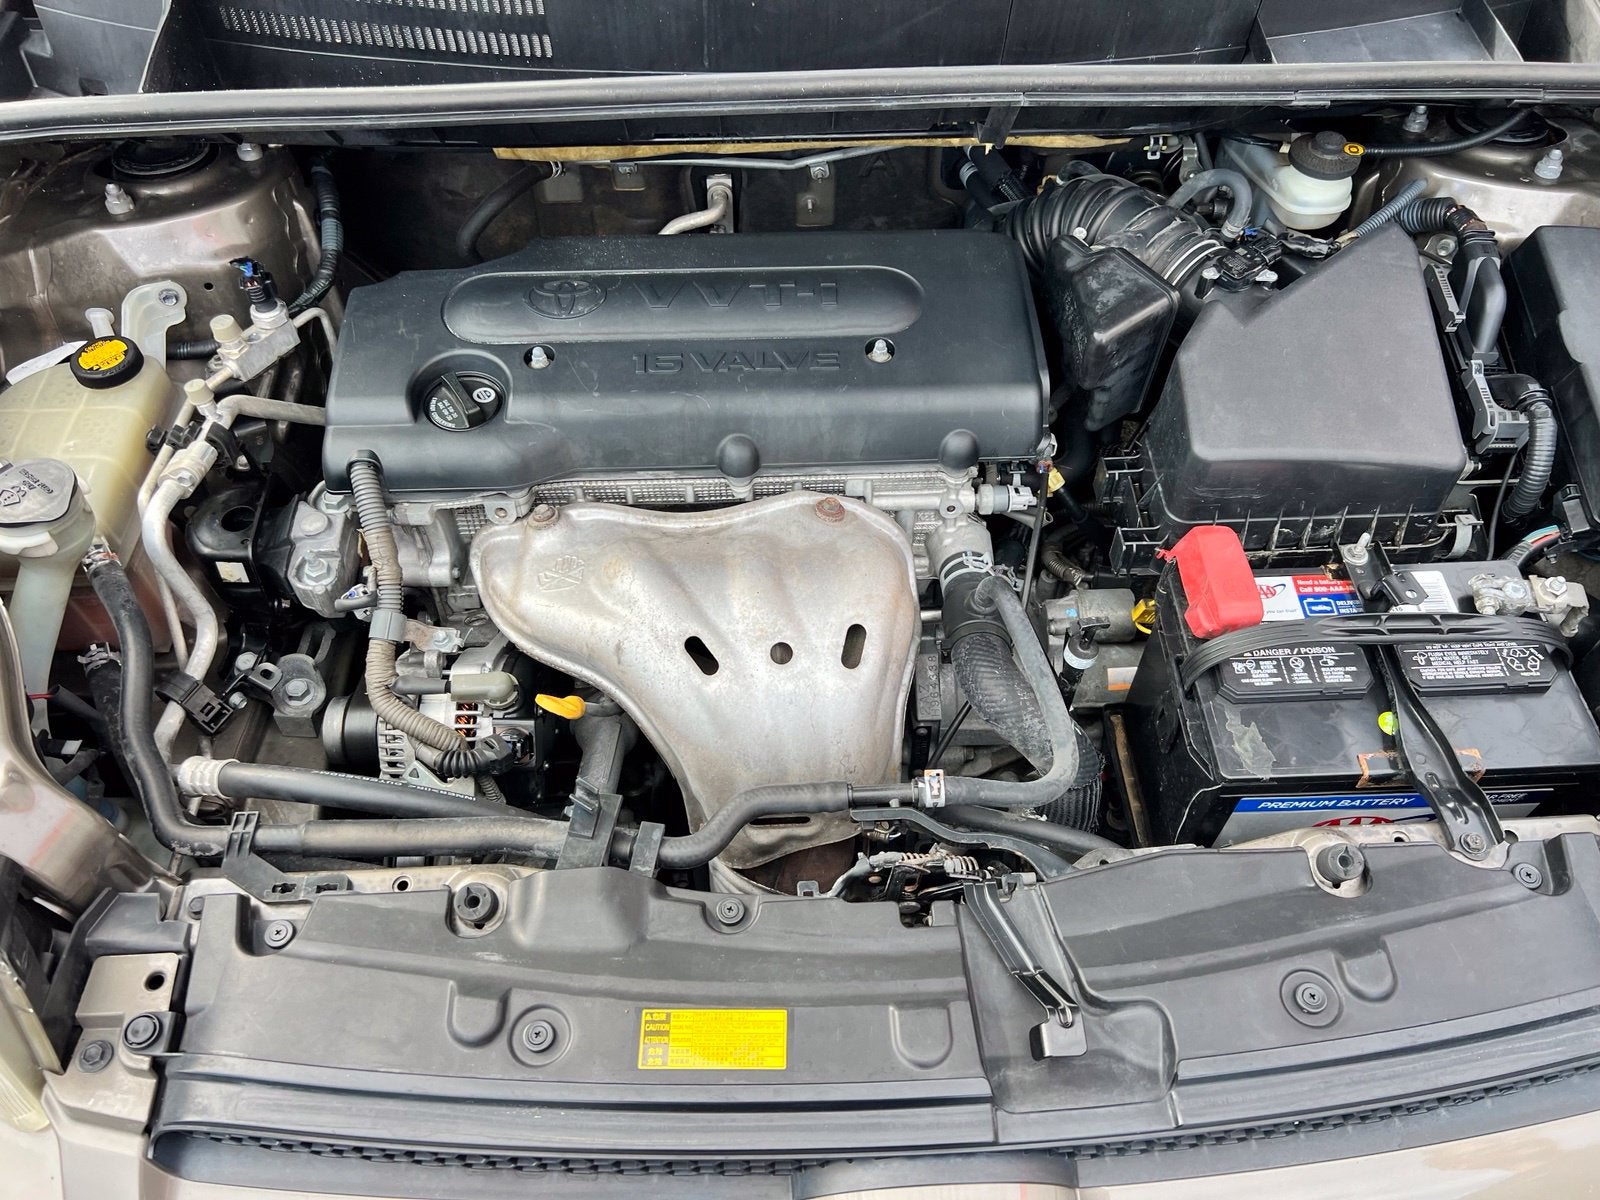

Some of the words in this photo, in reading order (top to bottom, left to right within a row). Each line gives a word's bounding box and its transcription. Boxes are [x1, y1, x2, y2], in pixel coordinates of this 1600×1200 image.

[689, 351, 840, 373] VALVE
[1253, 648, 1291, 656] DANGER
[1300, 646, 1335, 654] POISON
[1257, 800, 1337, 809] PREMIUM
[1337, 797, 1416, 807] BATTERY
[645, 1023, 670, 1031] CAUTION
